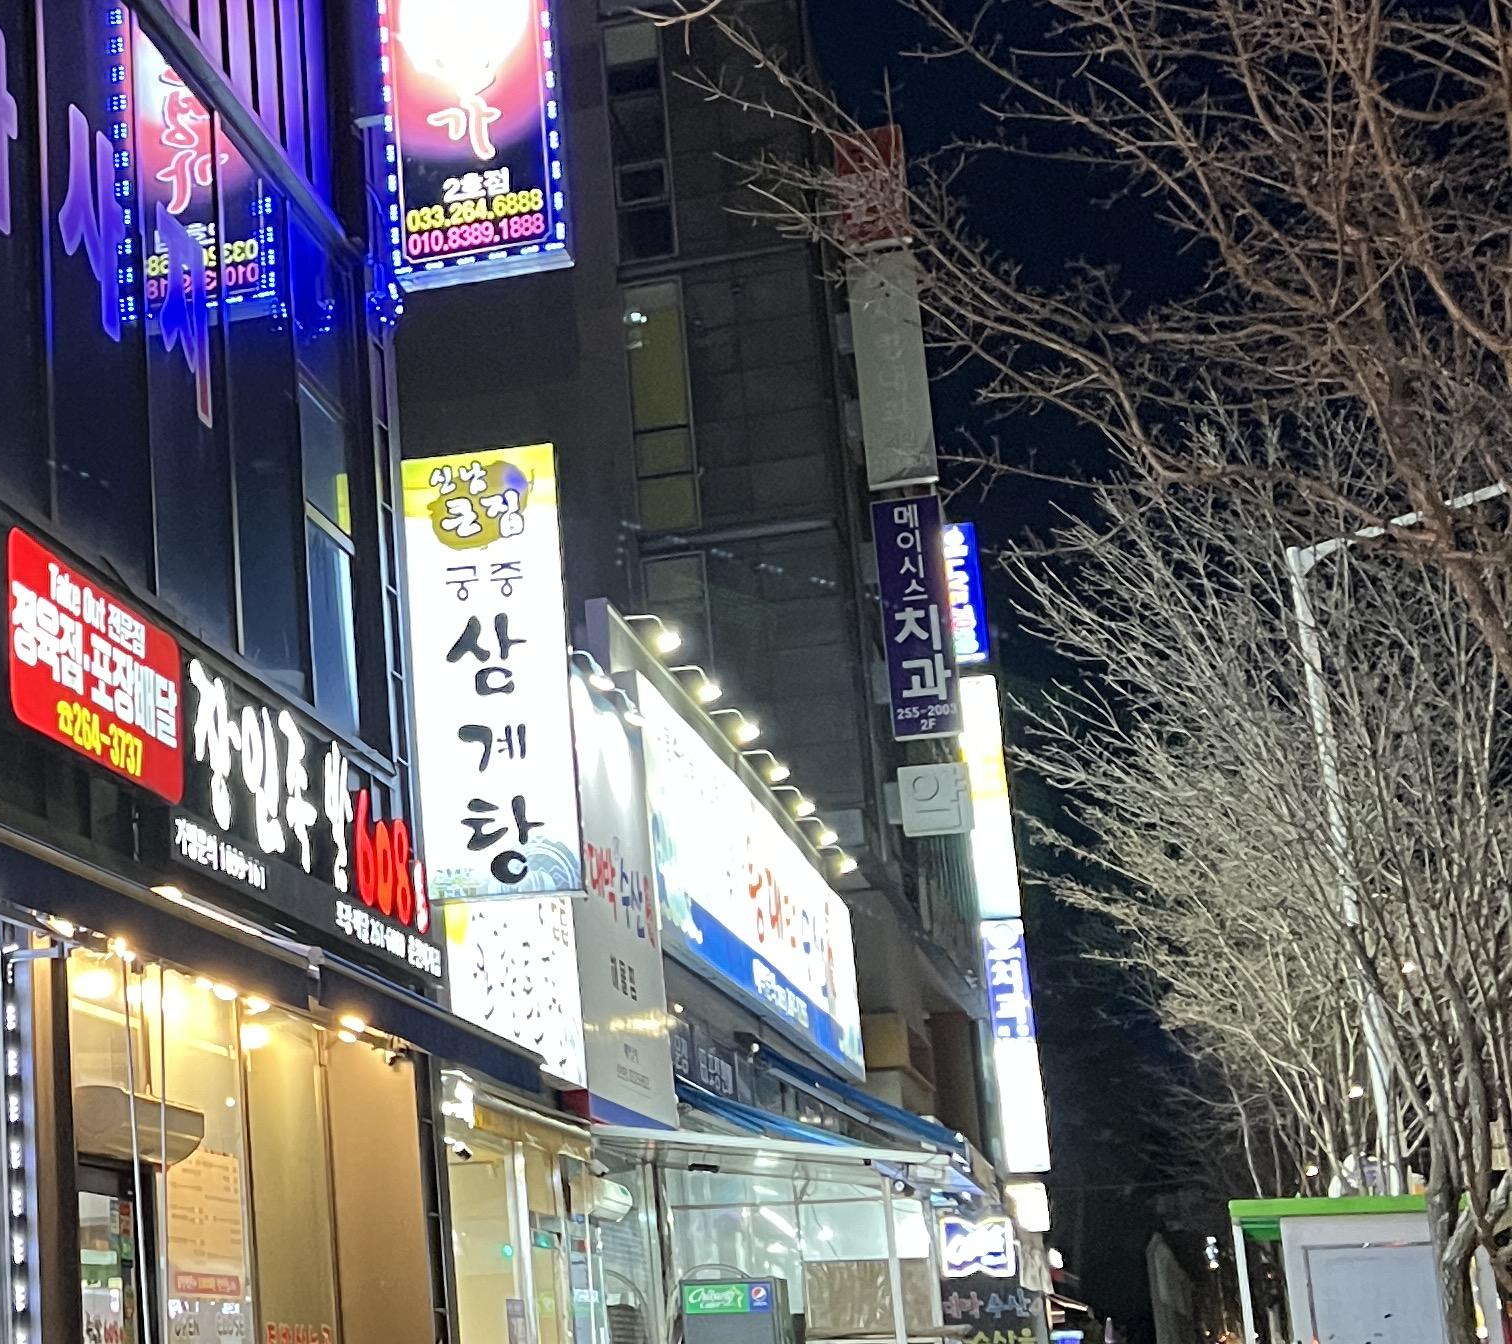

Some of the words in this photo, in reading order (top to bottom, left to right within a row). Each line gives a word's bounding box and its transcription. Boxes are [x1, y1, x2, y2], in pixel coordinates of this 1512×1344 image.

[441, 167, 510, 204] 2호점
[406, 190, 543, 232] 033.264.6888
[408, 217, 545, 256] 010.8389.1888
[441, 491, 526, 538] 큰집
[445, 561, 525, 602] 궁중
[48, 563, 81, 616] Take
[83, 586, 106, 634] Out
[108, 603, 146, 659] 전문점
[896, 705, 956, 721] 255-2003
[920, 719, 937, 732] 2F
[445, 612, 546, 884] 삼계탕
